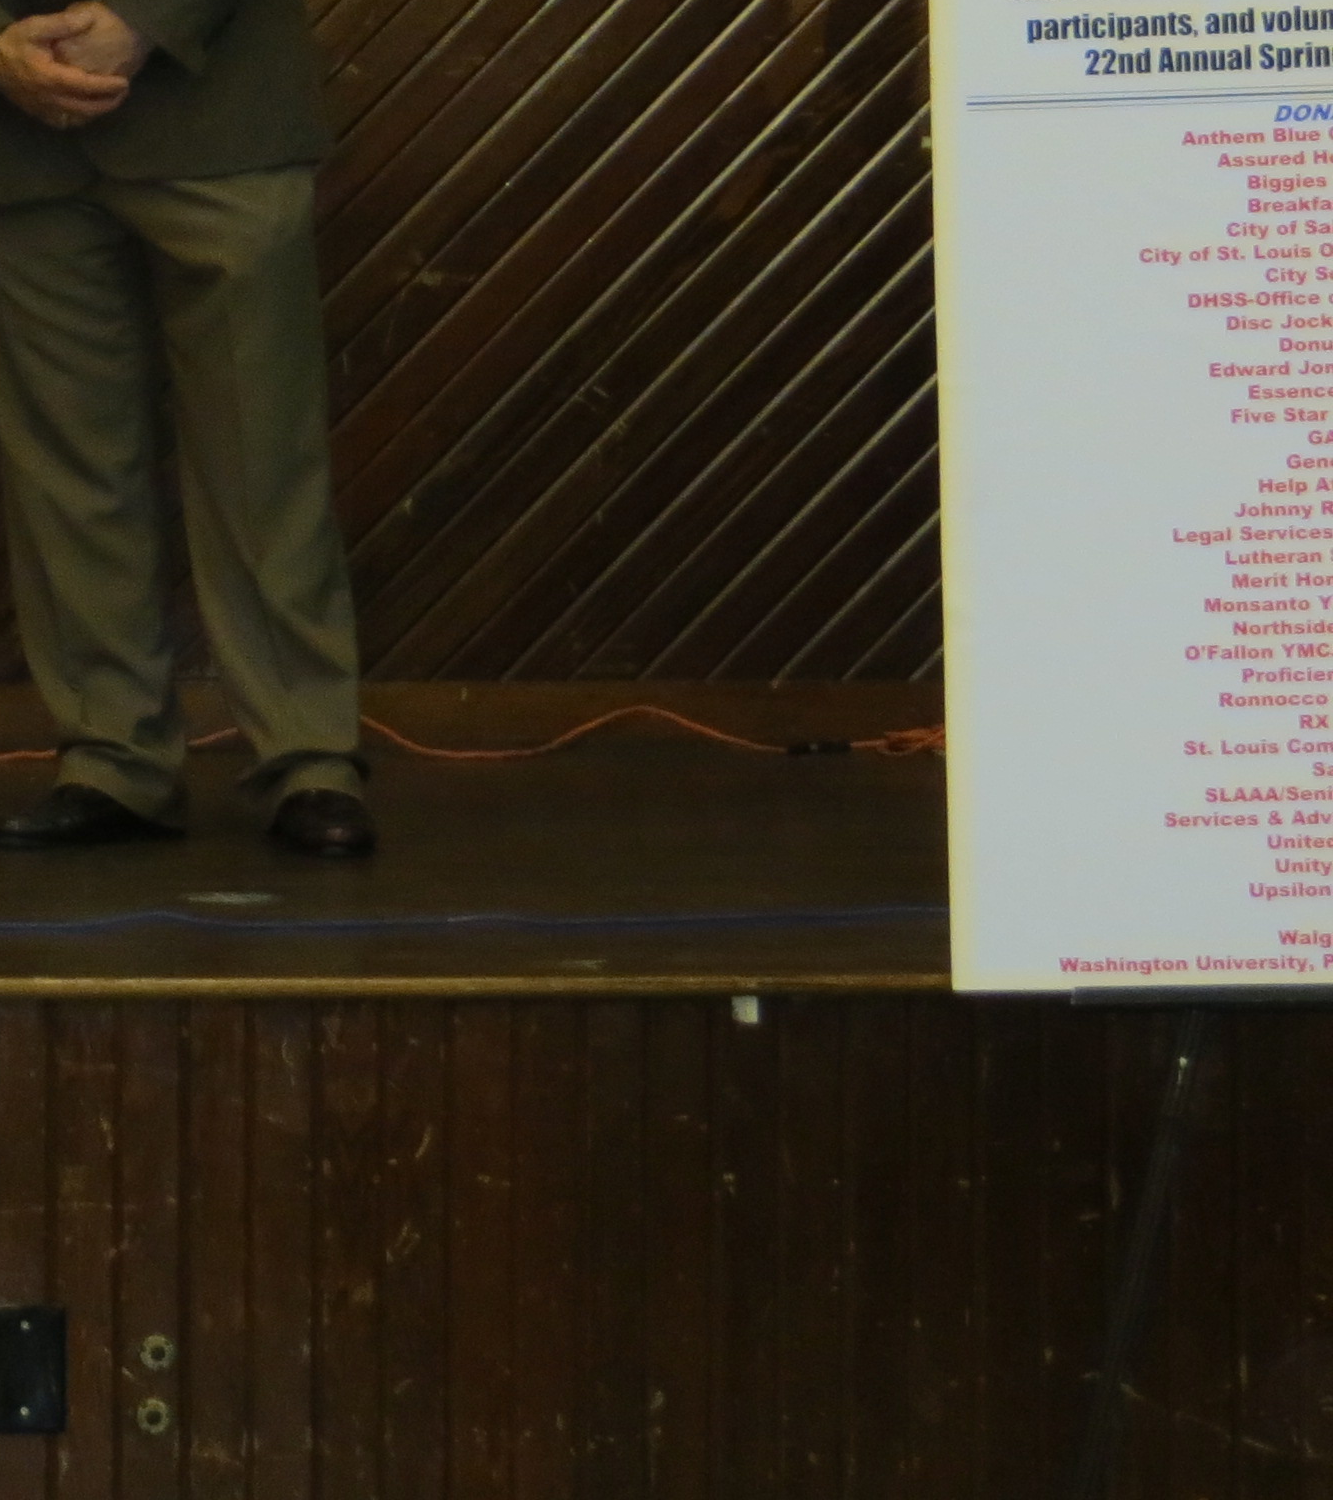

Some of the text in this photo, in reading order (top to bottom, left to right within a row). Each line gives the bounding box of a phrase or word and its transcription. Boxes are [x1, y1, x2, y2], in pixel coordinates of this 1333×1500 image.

[1027, 11, 1199, 45] participants,
[1205, 7, 1255, 36] and
[1085, 41, 1333, 77] 22nd Annual Sprin
[1273, 104, 1333, 123] DON
[1182, 129, 1265, 146] Anthem
[1273, 127, 1321, 143] Blue
[1217, 150, 1306, 168] Assured
[1247, 173, 1328, 194] Biggies
[1226, 221, 1270, 241] City
[1277, 220, 1298, 236] of
[1139, 247, 1183, 267] City
[1189, 246, 1211, 262] of
[1217, 245, 1246, 262] St.
[1254, 243, 1312, 260] Louis
[1265, 267, 1307, 286] City
[1188, 290, 1321, 309] DHSS-Office
[1226, 313, 1333, 331] Disc Jock
[1279, 337, 1333, 353] Donu
[1209, 360, 1291, 379] Edward
[1230, 406, 1329, 425] Five Star
[1285, 453, 1333, 470] Gen
[1258, 476, 1333, 497] Help A
[1234, 501, 1313, 520] Johnny
[1173, 525, 1333, 547] Legal Services
[1224, 550, 1323, 566] Lutheran
[1231, 573, 1288, 589] Merit
[1204, 597, 1311, 614] Monsanto
[1185, 642, 1333, 662] O'Fallon YMC
[1219, 691, 1329, 708] Ronnocco
[1299, 714, 1330, 730] RX
[1184, 739, 1214, 757] St.
[1221, 739, 1279, 756] Louis
[1164, 811, 1260, 830] Services
[1267, 810, 1284, 827] &
[1274, 858, 1332, 877] Unity
[1248, 881, 1332, 902] Upsilon
[1277, 929, 1332, 949] Walg
[1059, 956, 1190, 976] Washington
[1196, 953, 1316, 973] University,
